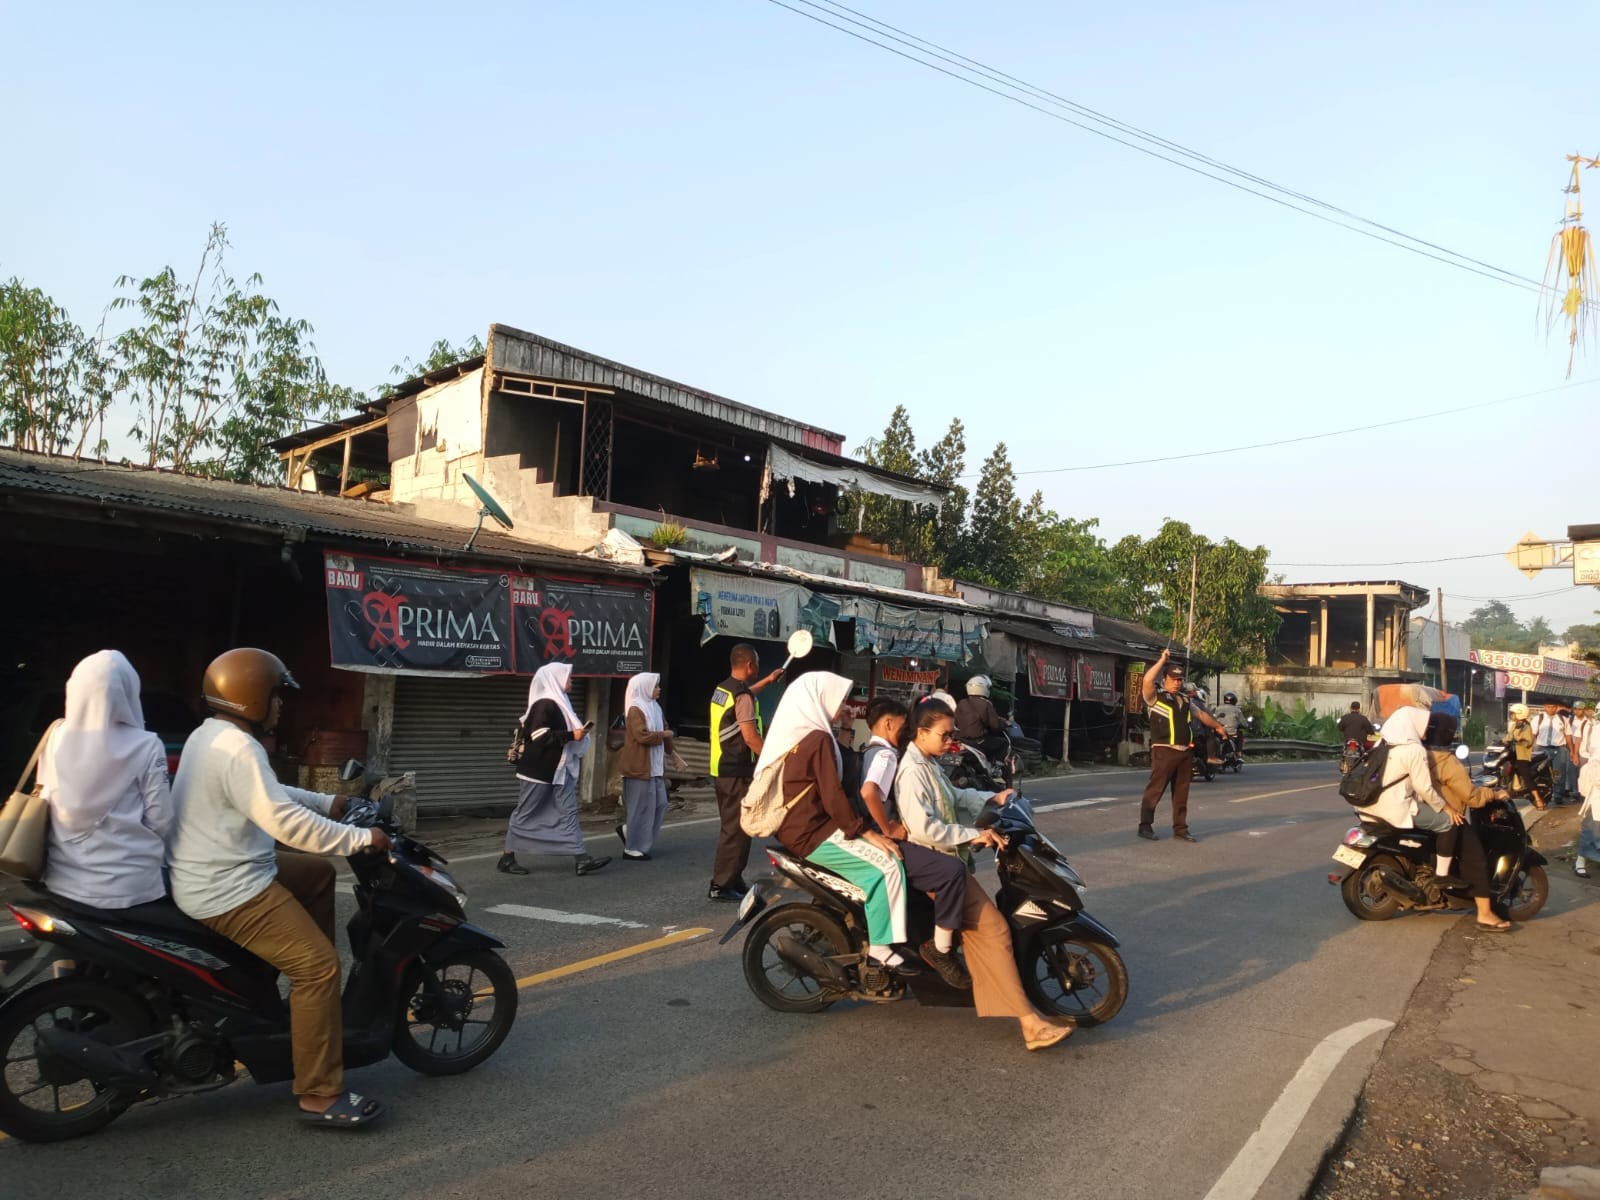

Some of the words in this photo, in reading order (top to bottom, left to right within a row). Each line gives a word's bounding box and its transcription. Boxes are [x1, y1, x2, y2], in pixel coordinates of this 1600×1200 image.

[328, 570, 360, 588] BARU
[514, 591, 538, 605] BARU
[398, 605, 500, 642] PRIMA
[568, 619, 643, 648] PRIMA
[1483, 653, 1543, 670] 35.000
[1043, 664, 1067, 682] PRIMA
